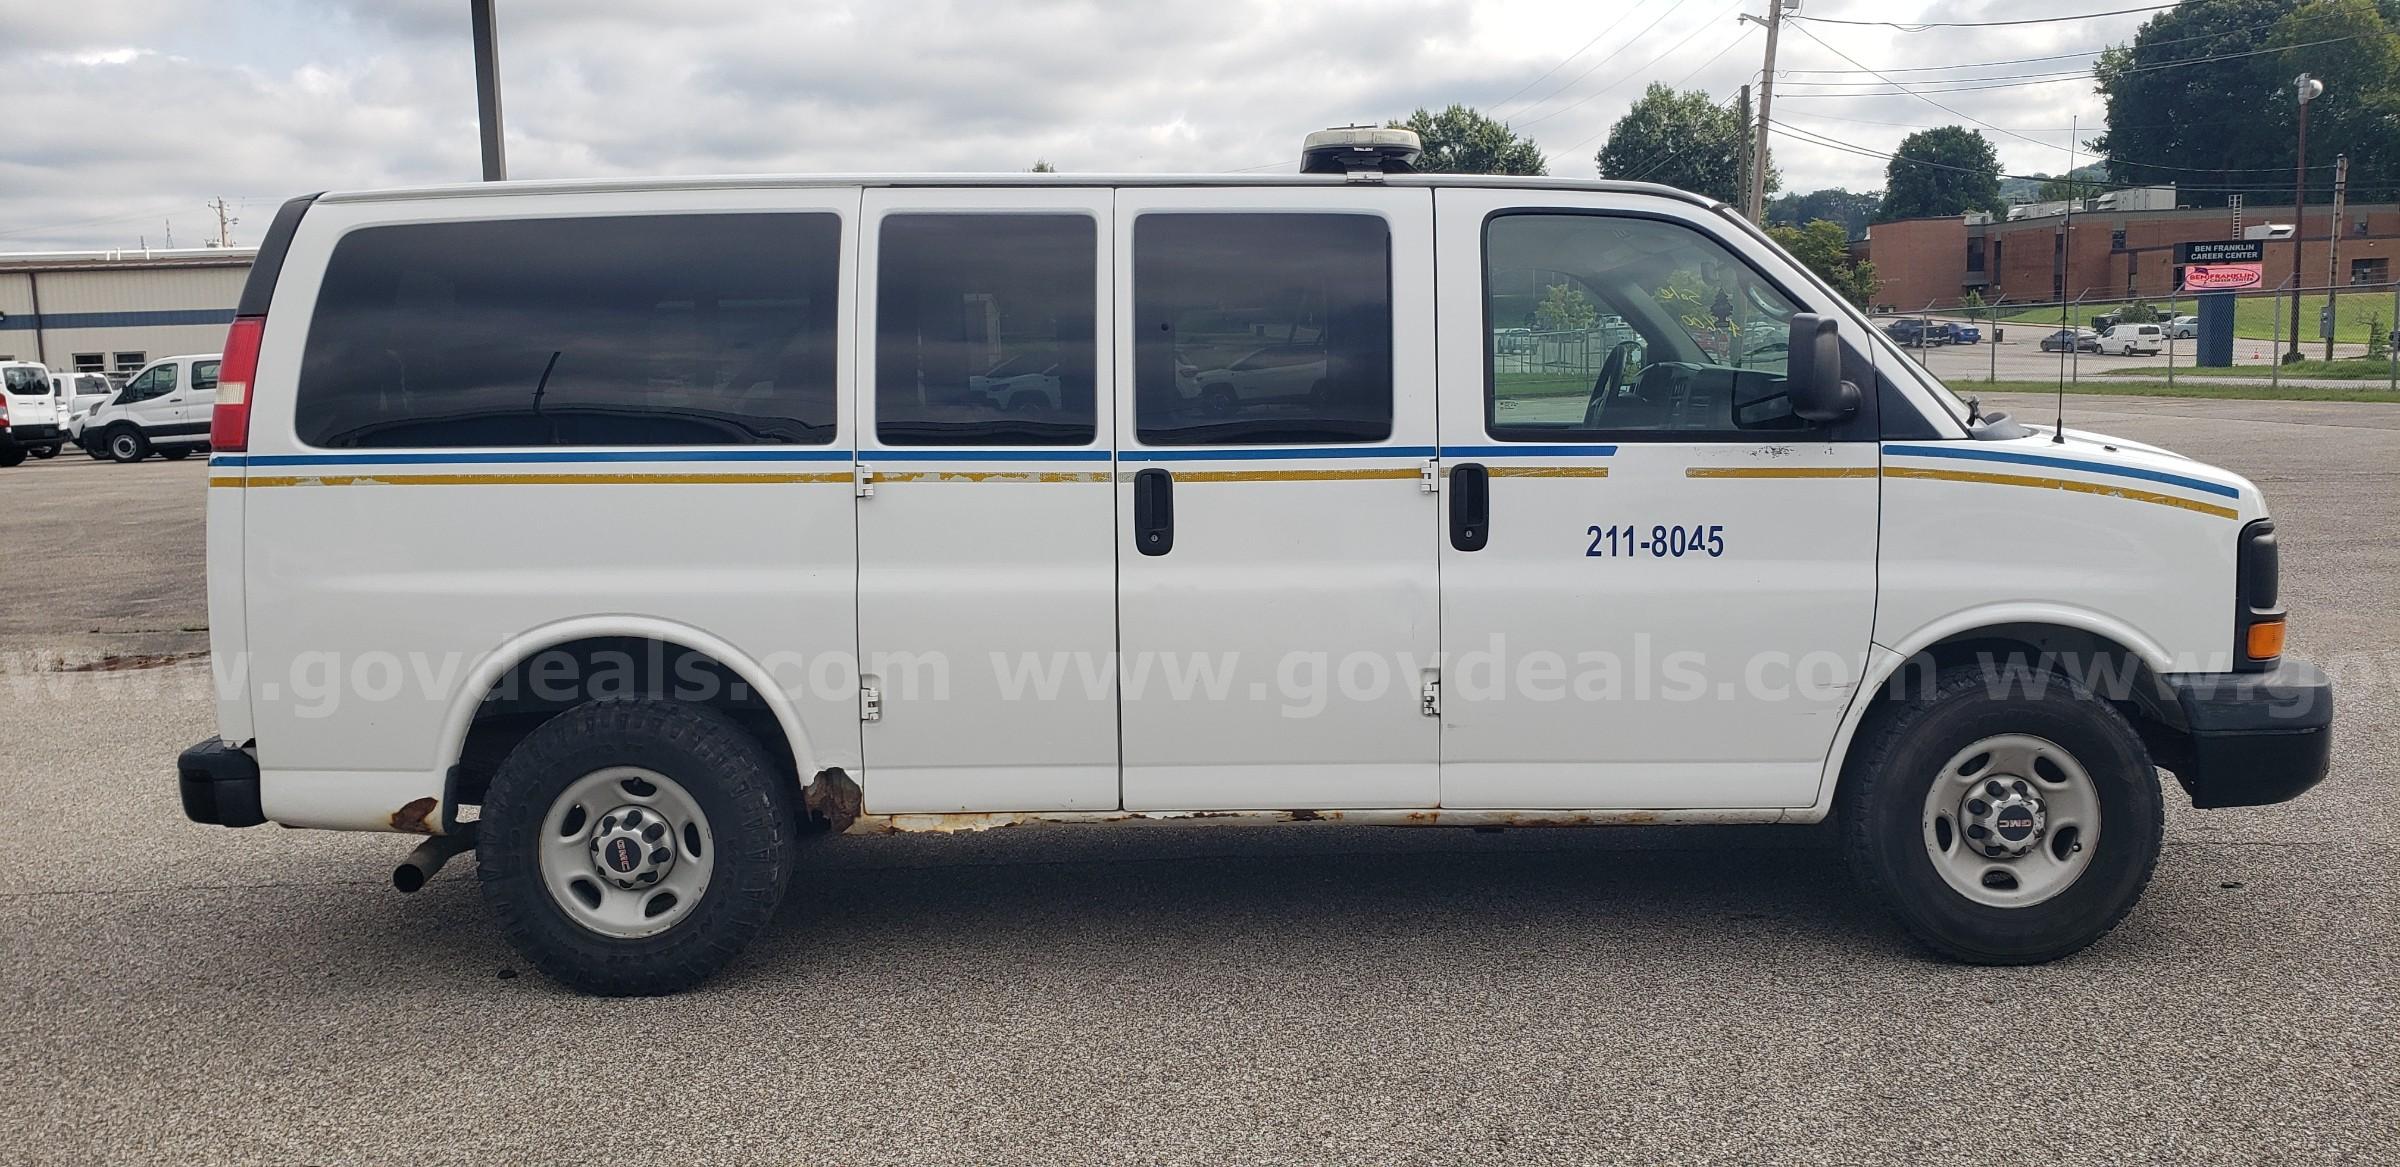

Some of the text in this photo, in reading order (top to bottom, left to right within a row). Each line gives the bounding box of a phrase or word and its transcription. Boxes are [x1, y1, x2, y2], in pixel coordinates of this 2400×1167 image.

[2191, 251, 2258, 260] CAREER CENTER
[1585, 525, 1724, 557] 211-8045
[1999, 820, 2032, 828] GMC
[616, 840, 630, 870] GMC
